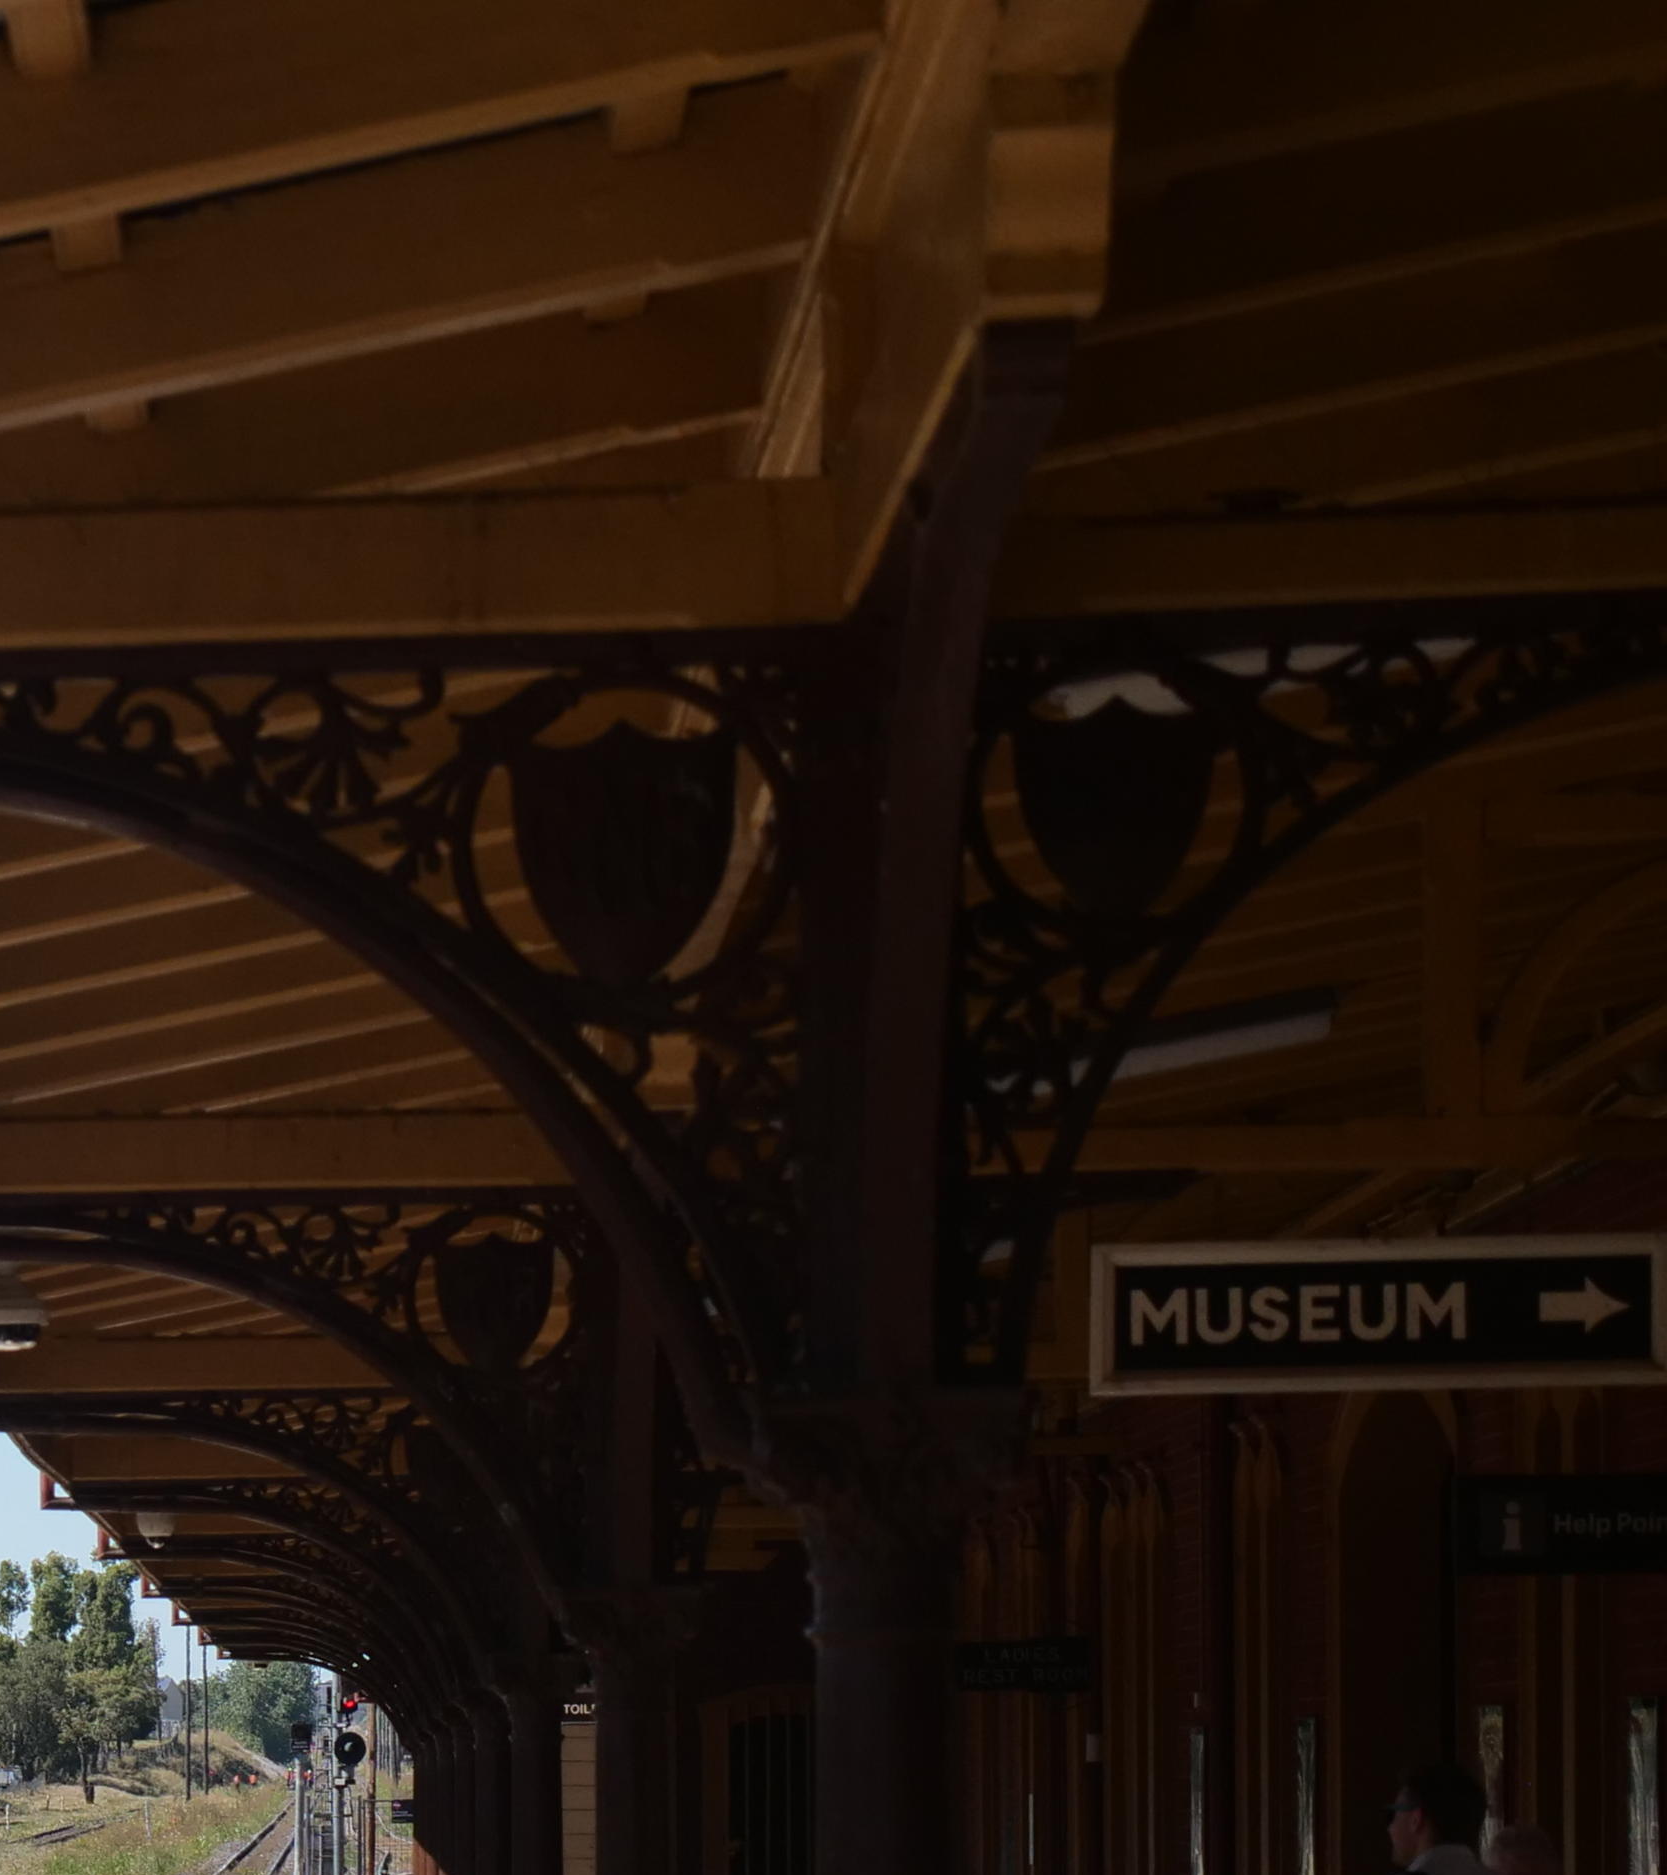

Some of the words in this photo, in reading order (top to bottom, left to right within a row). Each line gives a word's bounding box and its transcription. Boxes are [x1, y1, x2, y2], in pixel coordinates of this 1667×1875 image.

[1129, 1281, 1467, 1346] MUSEUM
[1553, 1512, 1610, 1538] Help
[983, 1646, 1060, 1663] LADIES
[962, 1667, 1020, 1684] REST
